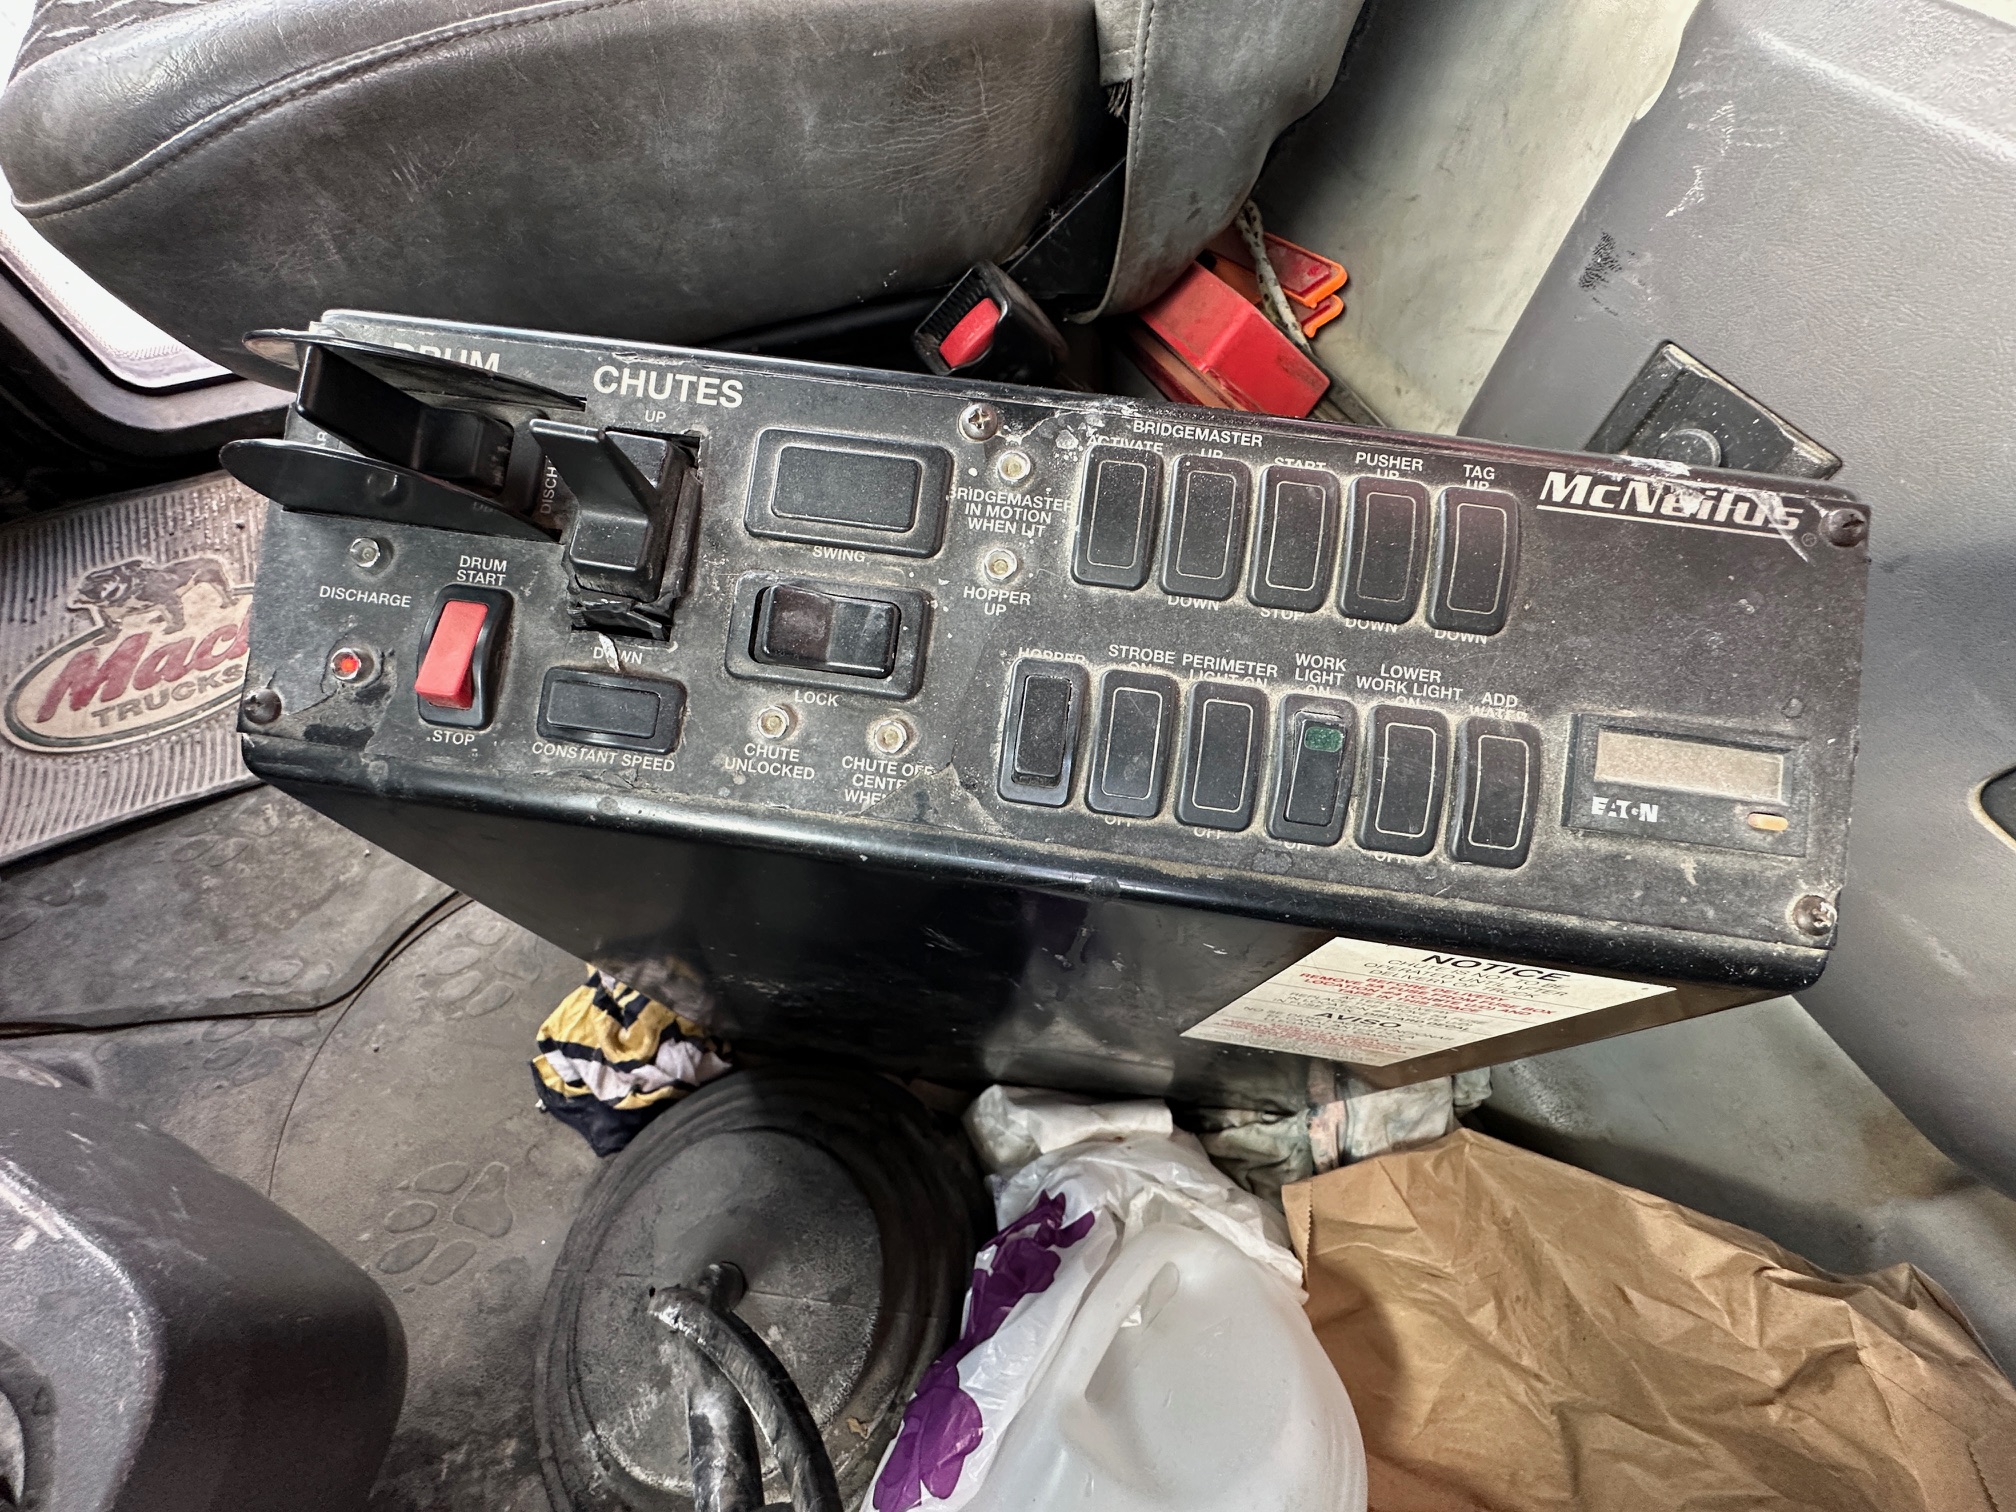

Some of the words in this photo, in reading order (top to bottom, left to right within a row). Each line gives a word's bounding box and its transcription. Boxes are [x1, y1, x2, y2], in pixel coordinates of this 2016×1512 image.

[593, 365, 743, 408] CHUTES
[645, 410, 666, 422] UP
[1133, 420, 1263, 447] BRIDGEMASTER
[1087, 435, 1164, 454] ACTIVATE
[1355, 452, 1424, 471] PUSHER
[1463, 464, 1495, 479] TAG
[540, 453, 557, 514] DISCH
[948, 486, 1072, 512] BRIDGEMASTER
[1539, 471, 1804, 531] McNeilus
[965, 503, 982, 516] IN
[986, 505, 1051, 524] MOTION
[968, 518, 1017, 534] WHEN
[1021, 523, 1046, 538] LIT
[459, 555, 507, 572] DRUM
[812, 546, 865, 562] SWING
[456, 570, 506, 586] START
[319, 585, 411, 607] DISCHARGE
[963, 585, 1031, 605] HOPPER
[1167, 595, 1219, 611] DOWN
[984, 603, 1007, 616] UP
[1345, 618, 1397, 633] DOWN
[1434, 629, 1487, 645] DOWN
[593, 646, 643, 665] DWN
[1108, 644, 1176, 665] STROBE
[1295, 653, 1348, 671] WORK
[1182, 653, 1278, 678] PERIMETER
[1380, 663, 1442, 683] LOWER
[1295, 668, 1344, 686] LIGHT
[91, 663, 244, 728] TRUCKS
[1356, 675, 1407, 694] WORK
[1413, 682, 1464, 701] LIGHT
[795, 690, 839, 707] LOCK
[1481, 691, 1518, 708] ADD
[1469, 704, 1528, 722] WATER
[432, 730, 475, 746] STOP
[532, 742, 618, 765] CONSTANT
[621, 754, 675, 772] SPEED
[744, 743, 800, 762] CHUTE
[725, 757, 815, 780] UNLOCKED
[842, 755, 897, 775] CHUTE
[853, 773, 908, 791] CENTE
[845, 789, 886, 805] WHE
[1591, 796, 1658, 823] EATON
[1387, 959, 1449, 972] CHUTE
[1471, 972, 1512, 981] NOT
[1421, 954, 1570, 981] NOTICE
[1300, 973, 1362, 985] REMOVE
[1363, 962, 1456, 979] OPERATED
[1457, 976, 1505, 986] UNTIL
[1510, 984, 1569, 996] AFTER
[1369, 969, 1449, 984] DELIVERY
[1480, 986, 1540, 997] TRUCK
[1432, 987, 1507, 1001] DELIVERY
[1315, 1011, 1403, 1028] AVISO
